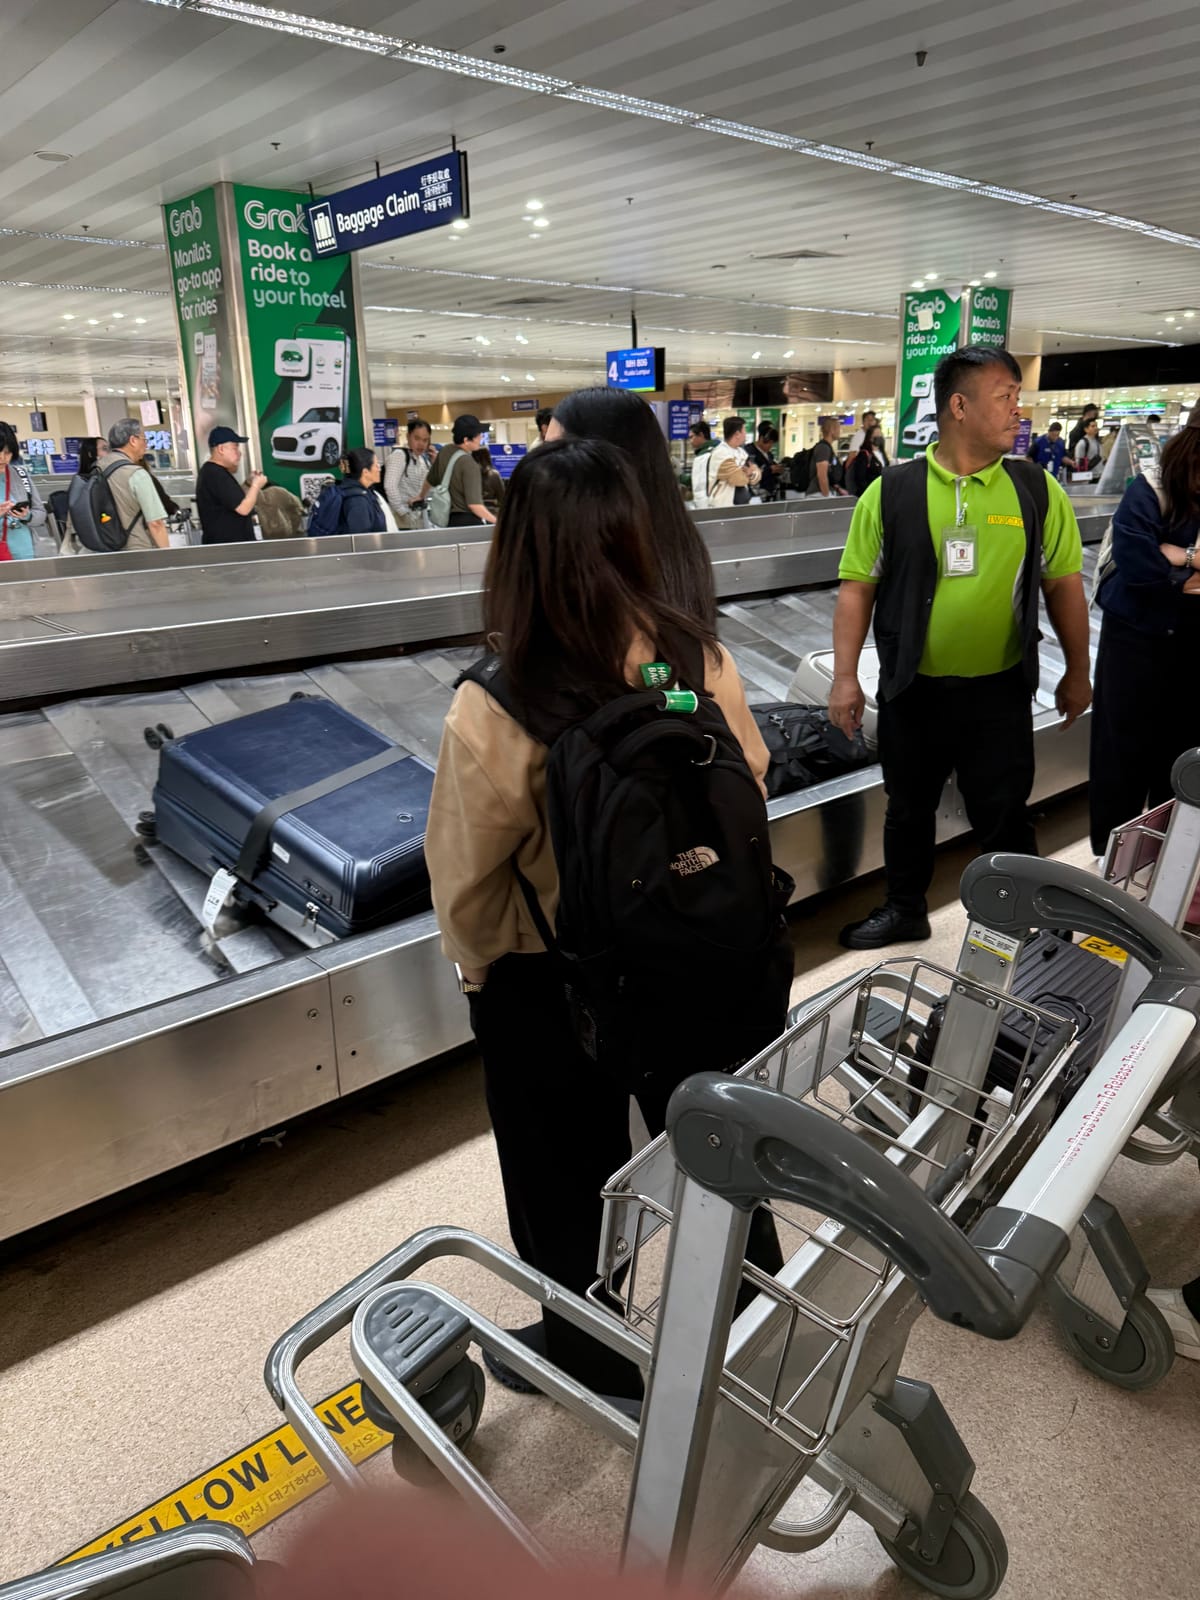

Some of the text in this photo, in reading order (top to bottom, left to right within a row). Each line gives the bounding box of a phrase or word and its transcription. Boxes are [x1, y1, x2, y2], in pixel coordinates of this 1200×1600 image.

[169, 200, 202, 237] Grab
[336, 204, 385, 234] Baggage
[385, 190, 420, 217] Claim
[174, 241, 212, 269] Manila's
[247, 239, 312, 262] Book a
[177, 267, 222, 298] go-to app
[250, 262, 311, 286] ride to
[181, 296, 218, 321] for rides
[253, 287, 347, 309] your hotel
[973, 292, 998, 311] Grab
[933, 321, 941, 330] a
[972, 315, 1001, 330] Manila's
[906, 334, 938, 345] ride to
[971, 332, 1005, 346] go-to app
[906, 342, 957, 359] your hotel
[608, 361, 619, 381] 4
[676, 849, 697, 861] THE
[680, 863, 704, 877] FACE
[1121, 1051, 1142, 1064] The
[1104, 1063, 1134, 1091] Release
[1097, 1090, 1116, 1101] To
[1083, 1100, 1111, 1123] Down
[106, 1395, 369, 1550] LOW LNE
[229, 1502, 264, 1525] 에서
[268, 1465, 322, 1502] 대기하여
